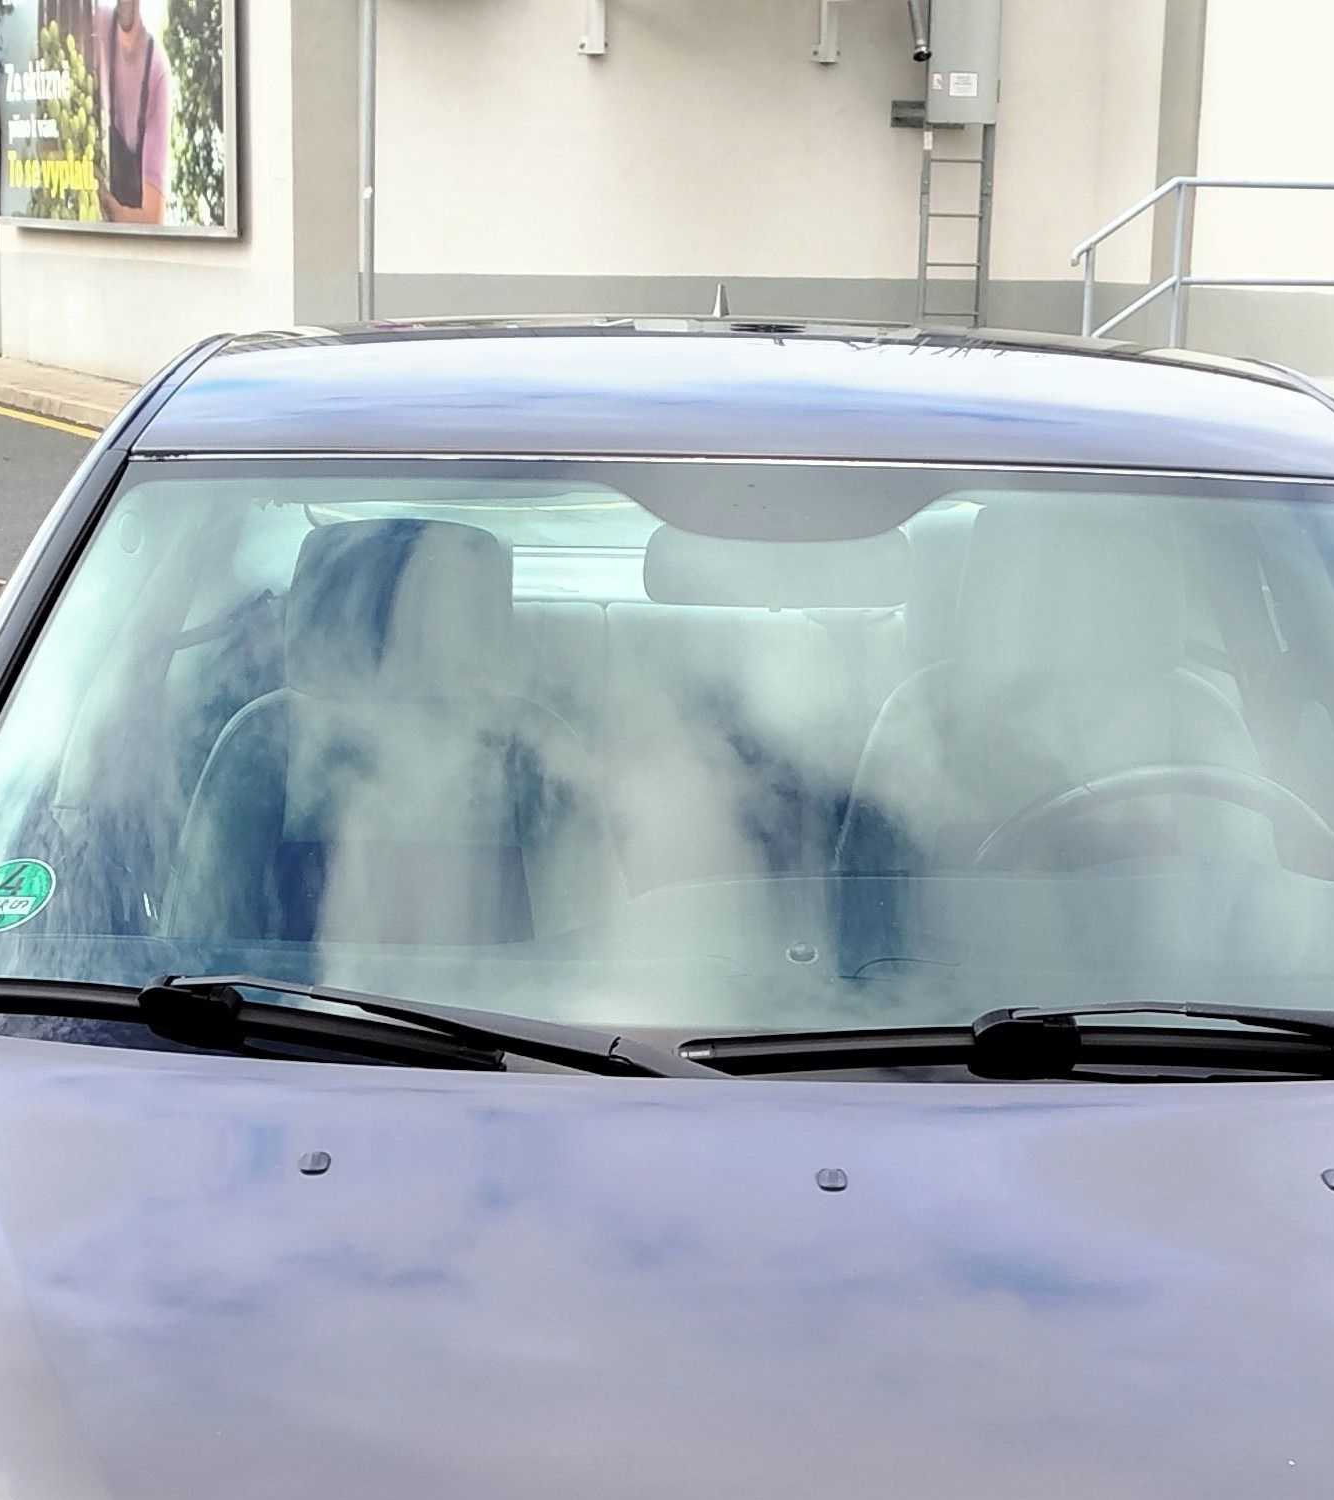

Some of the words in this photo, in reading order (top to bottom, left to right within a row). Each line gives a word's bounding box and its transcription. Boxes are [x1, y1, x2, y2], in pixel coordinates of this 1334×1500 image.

[4, 63, 22, 100] Ze
[8, 151, 23, 188] To
[24, 159, 40, 189] se
